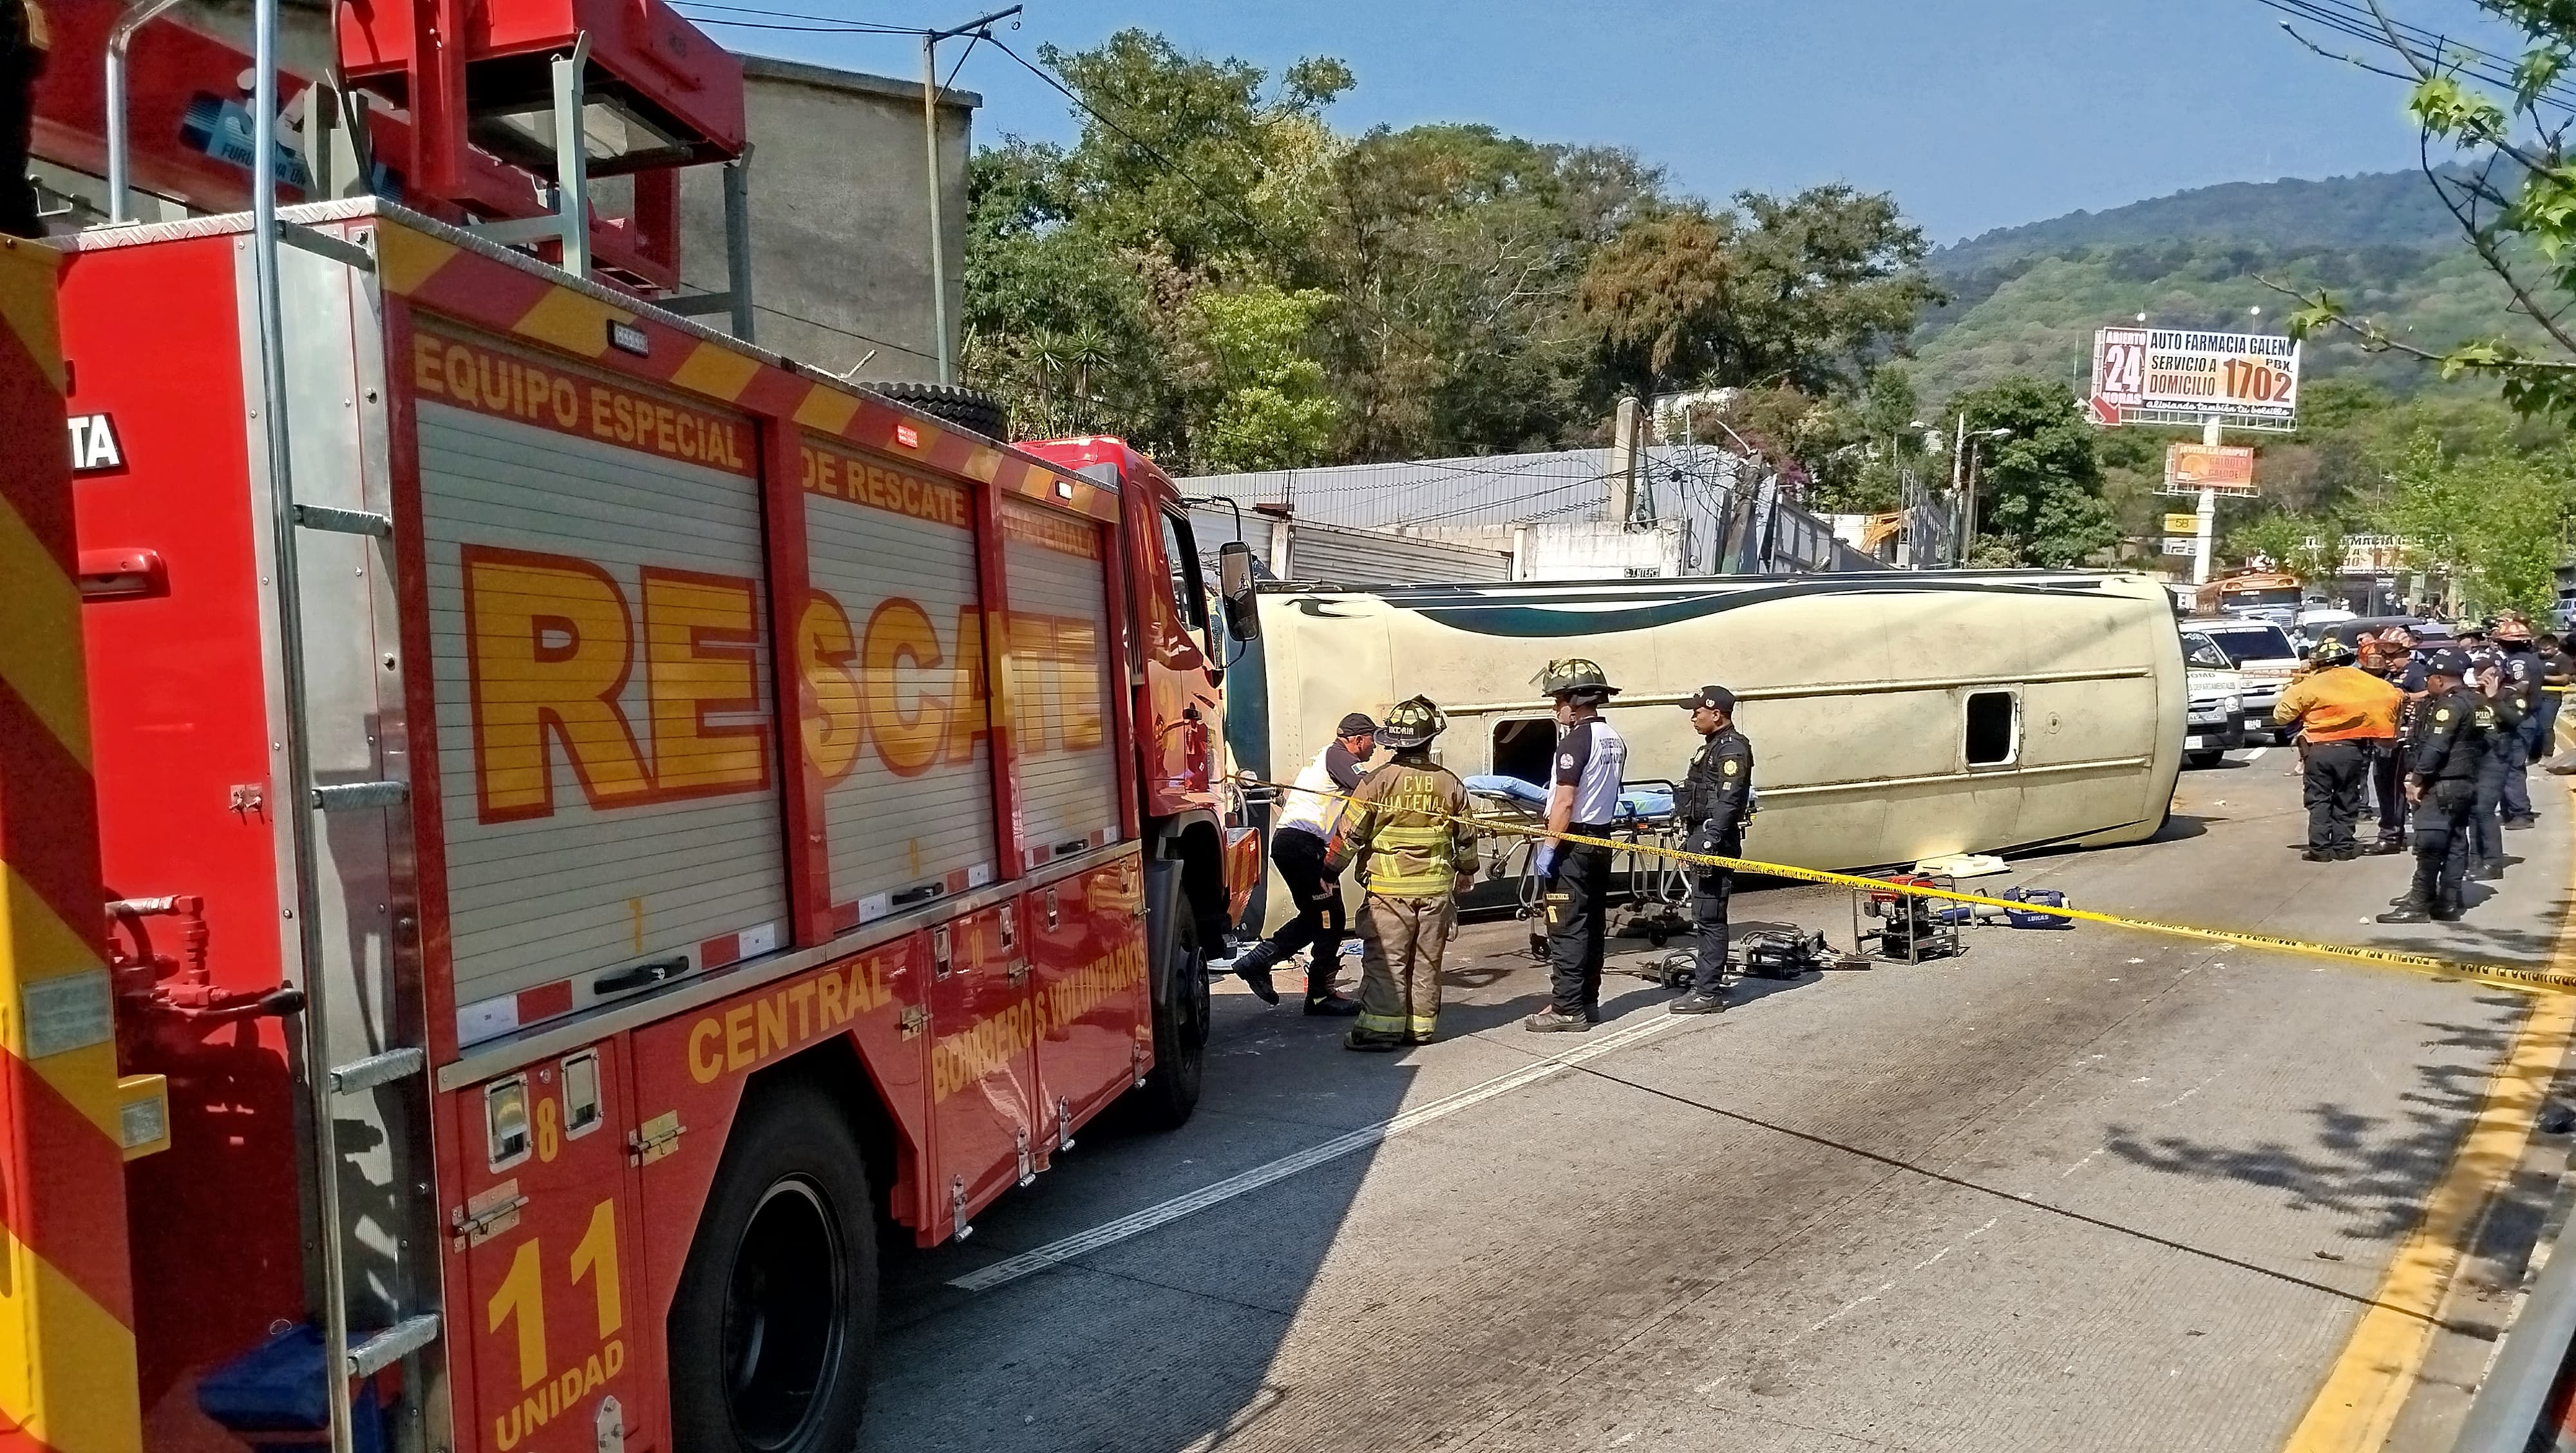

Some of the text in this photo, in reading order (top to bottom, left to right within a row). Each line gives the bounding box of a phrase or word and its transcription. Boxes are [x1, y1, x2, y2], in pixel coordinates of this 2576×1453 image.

[2106, 332, 2146, 345] ABIERTO
[2150, 332, 2293, 356] AUTO FARMACIA GALENO
[2152, 356, 2216, 372] SERVICIO A
[2105, 345, 2141, 392] 24
[2150, 375, 2215, 396] DOMICILIO
[2223, 358, 2292, 403] 1702
[413, 333, 743, 468] EQUIPO ESPECIAL
[2102, 392, 2142, 404] HORAS
[801, 445, 965, 526] DE RESCATE
[1003, 504, 1097, 559] UATEMALA
[461, 544, 1104, 825] RESCATE
[1404, 775, 1434, 792] CVB
[969, 928, 984, 968] 10
[688, 957, 893, 1084] CENTRAL
[932, 936, 1146, 1105] BOMBEROS VOLUNTARIOS
[536, 1097, 558, 1163] 8
[488, 1197, 623, 1392] 11
[495, 1339, 625, 1452] UNIDAD
